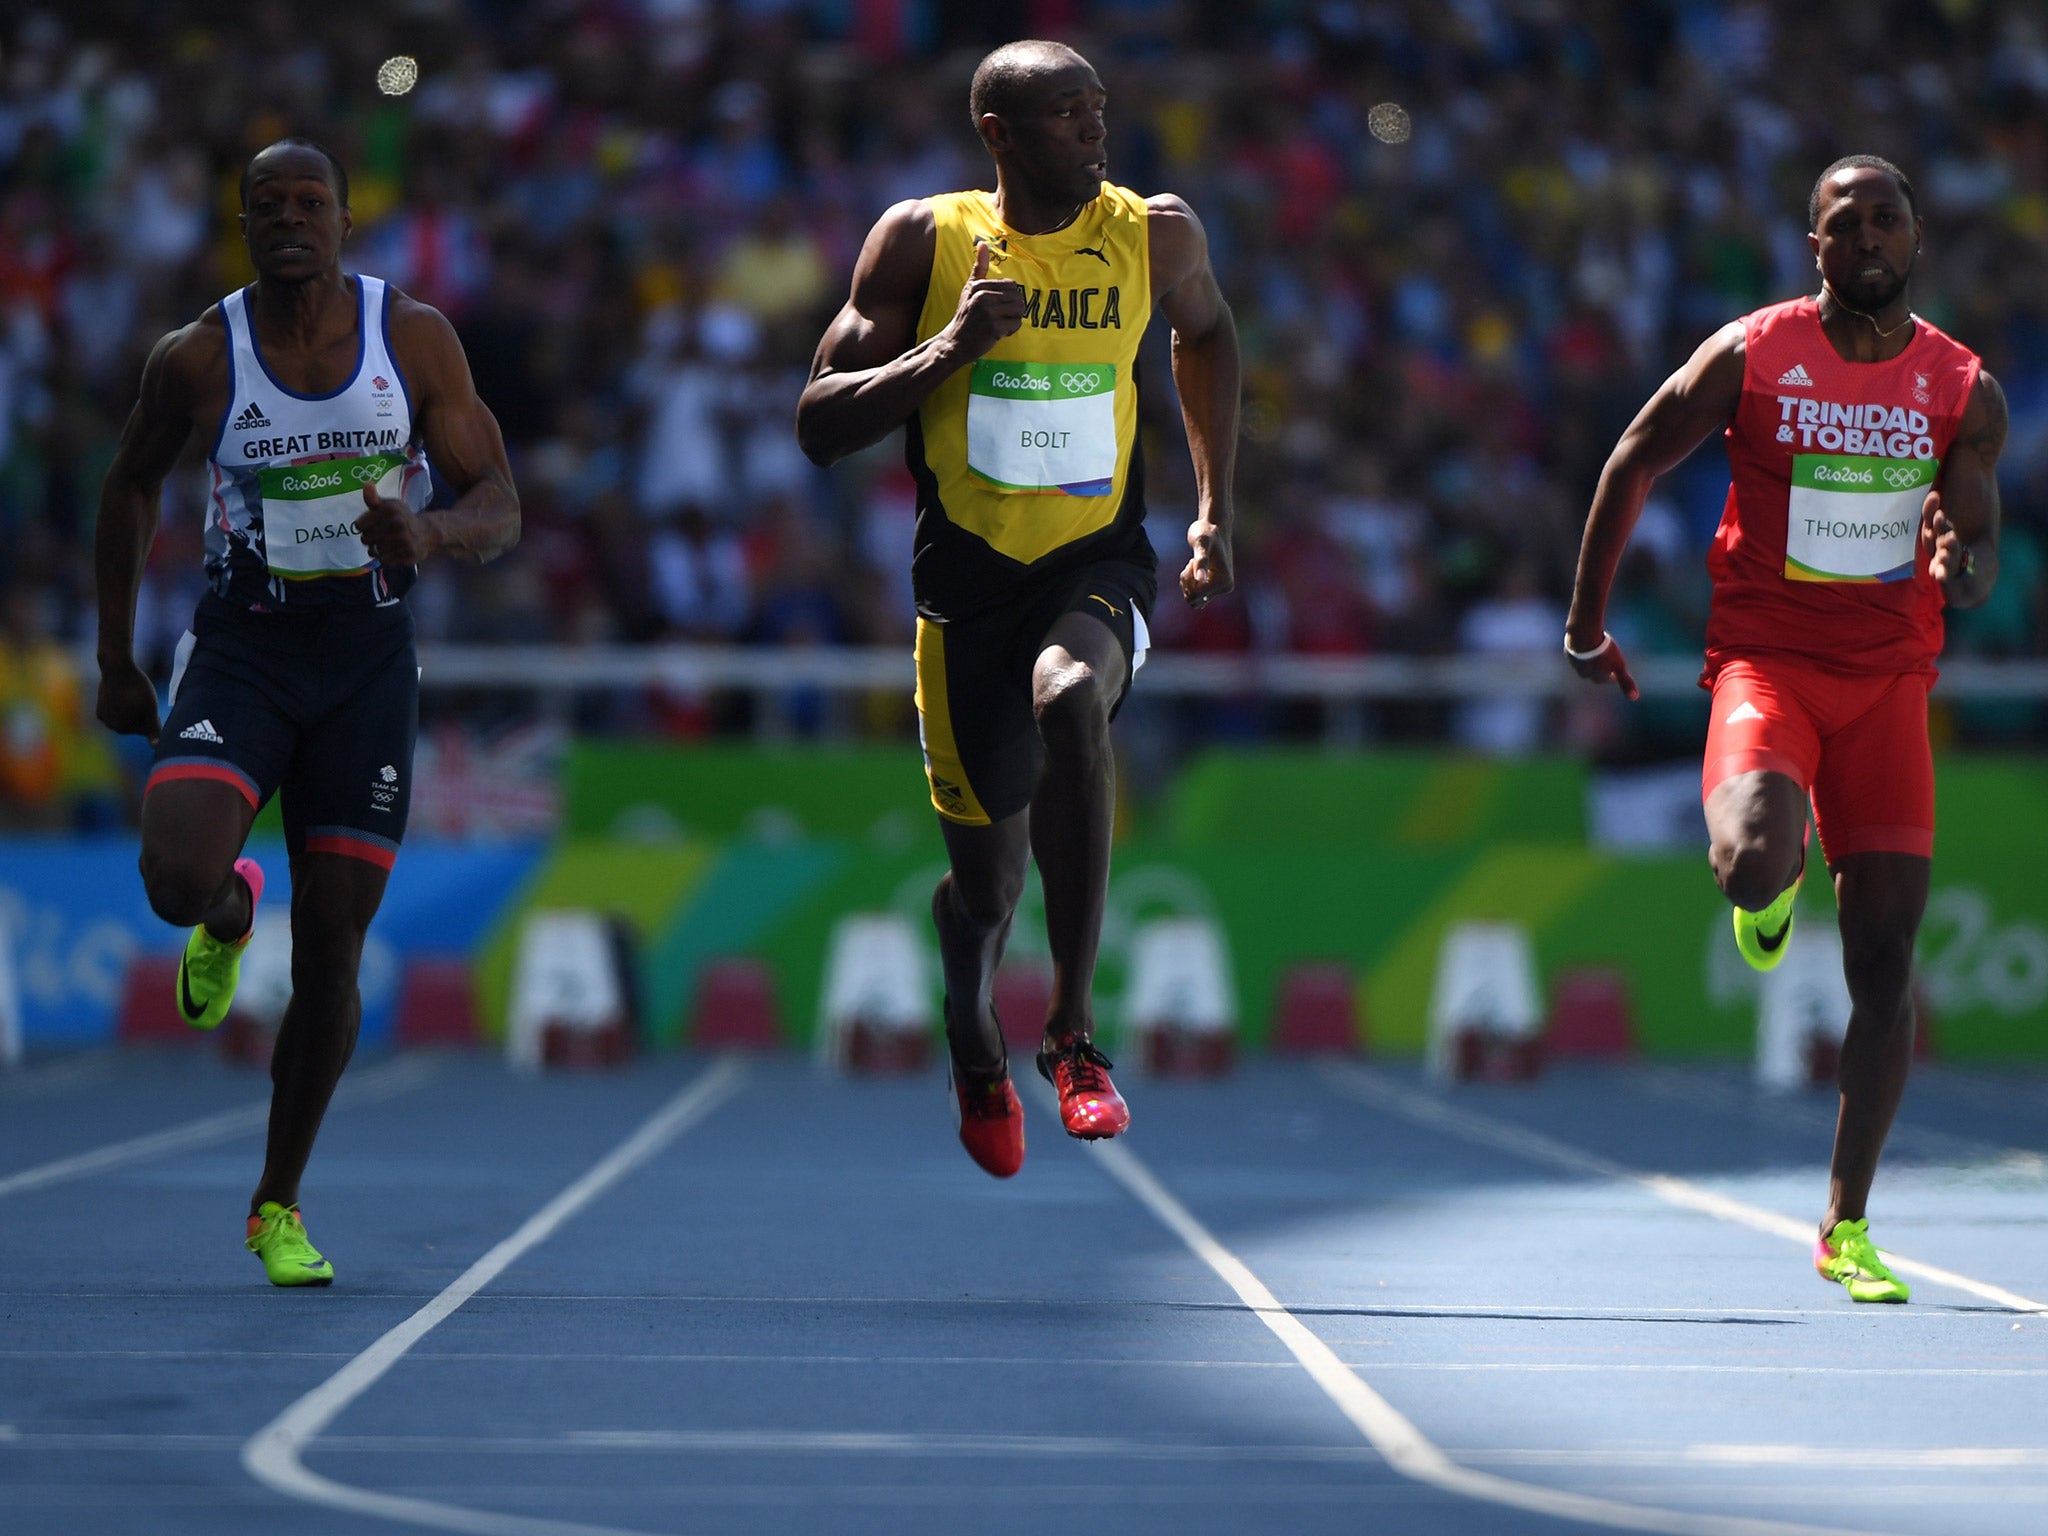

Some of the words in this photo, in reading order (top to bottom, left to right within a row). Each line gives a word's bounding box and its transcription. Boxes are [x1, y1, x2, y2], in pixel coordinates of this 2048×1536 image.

[1017, 284, 1121, 329] MAICA
[992, 371, 1052, 391] Rio2016
[1777, 376, 1813, 387] adidas
[233, 417, 272, 431] adidas
[1776, 395, 1929, 435] TRINIDAD
[243, 434, 311, 459] GREAT
[317, 428, 399, 450] BRITAIN
[1020, 430, 1071, 449] BOLT
[282, 470, 343, 492] Rio2016
[1814, 465, 1873, 484] Rio2016
[1804, 518, 1910, 540] THOMPSON
[179, 730, 224, 745] adidas
